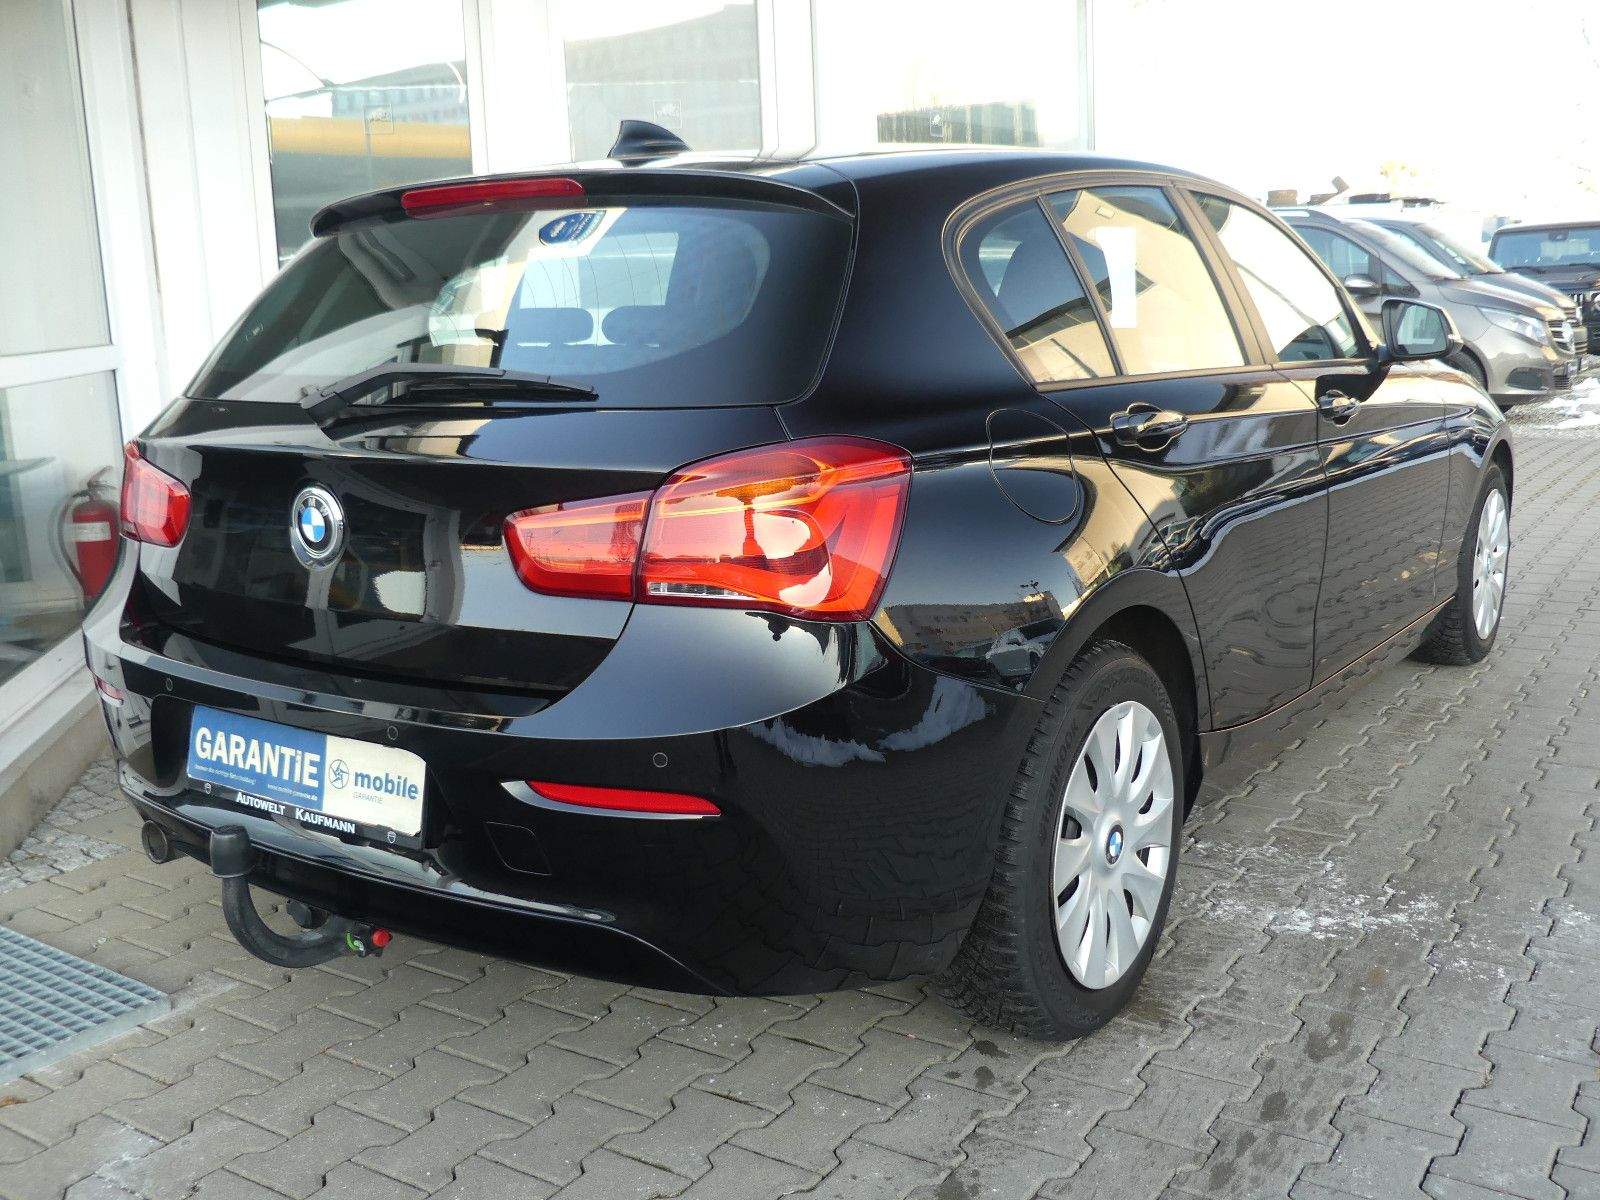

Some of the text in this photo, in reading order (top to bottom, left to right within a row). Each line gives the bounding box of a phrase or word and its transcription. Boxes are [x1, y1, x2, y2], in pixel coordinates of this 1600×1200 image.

[355, 771, 418, 800] mobile
[237, 791, 286, 816] AUTOWELT
[295, 807, 356, 834] KAUFMANN
